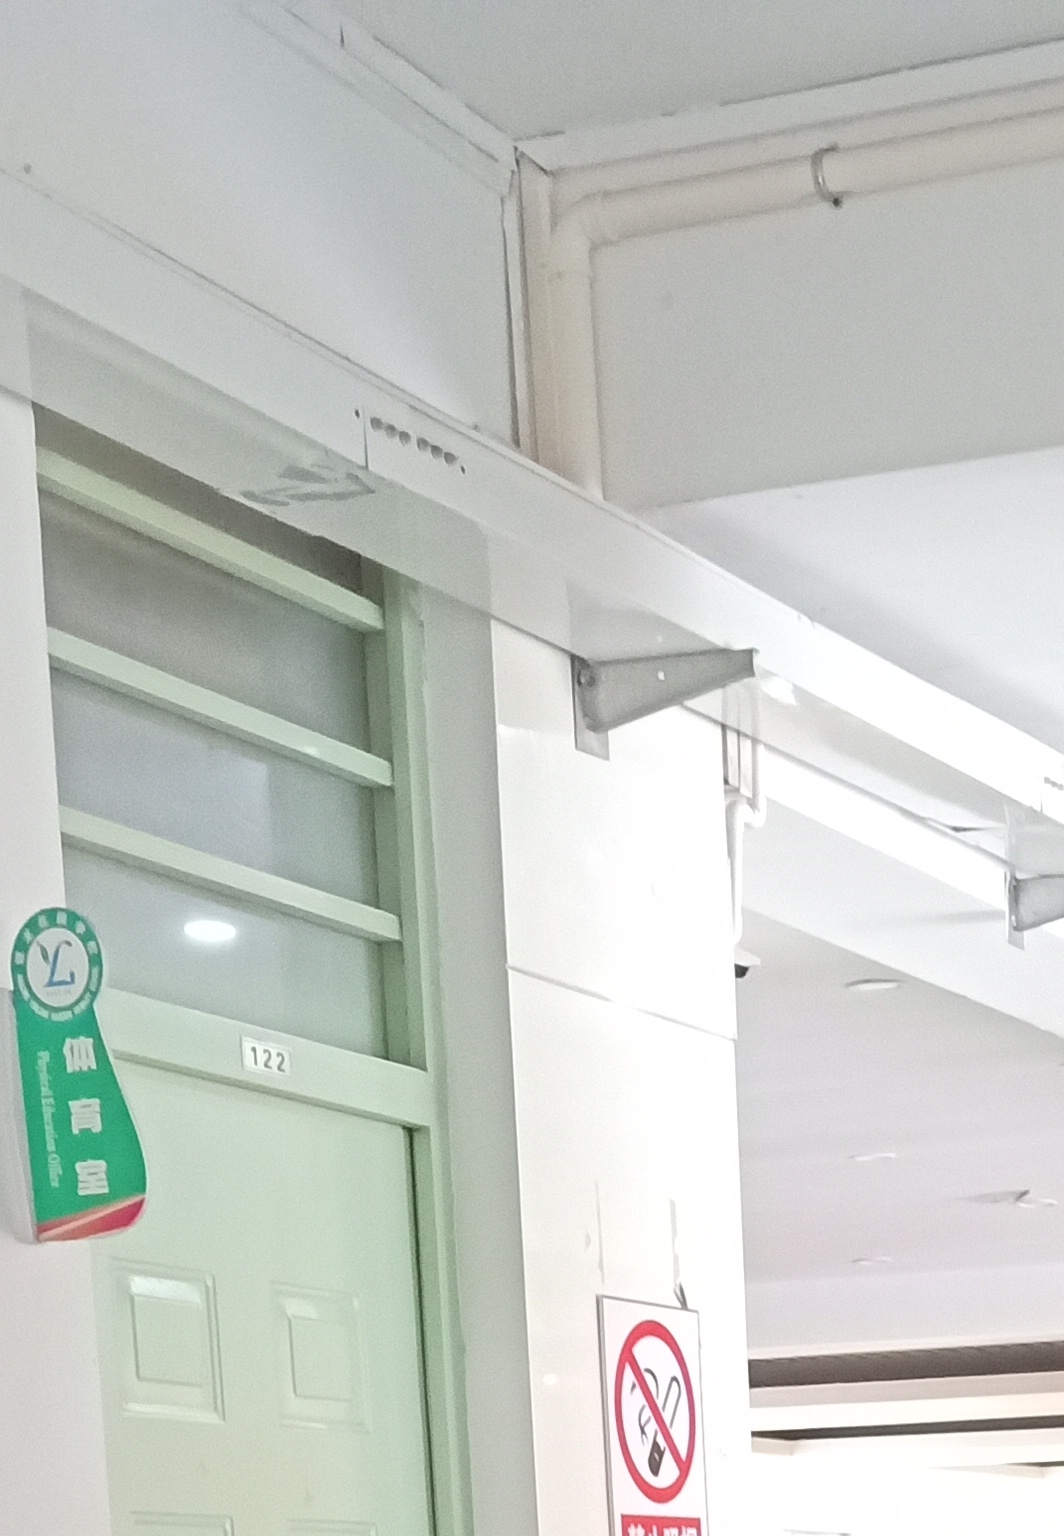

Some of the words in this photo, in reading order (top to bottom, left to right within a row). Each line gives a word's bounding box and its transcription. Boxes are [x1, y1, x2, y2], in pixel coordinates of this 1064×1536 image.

[251, 1046, 286, 1073] 122
[63, 1036, 109, 1196] 体育室
